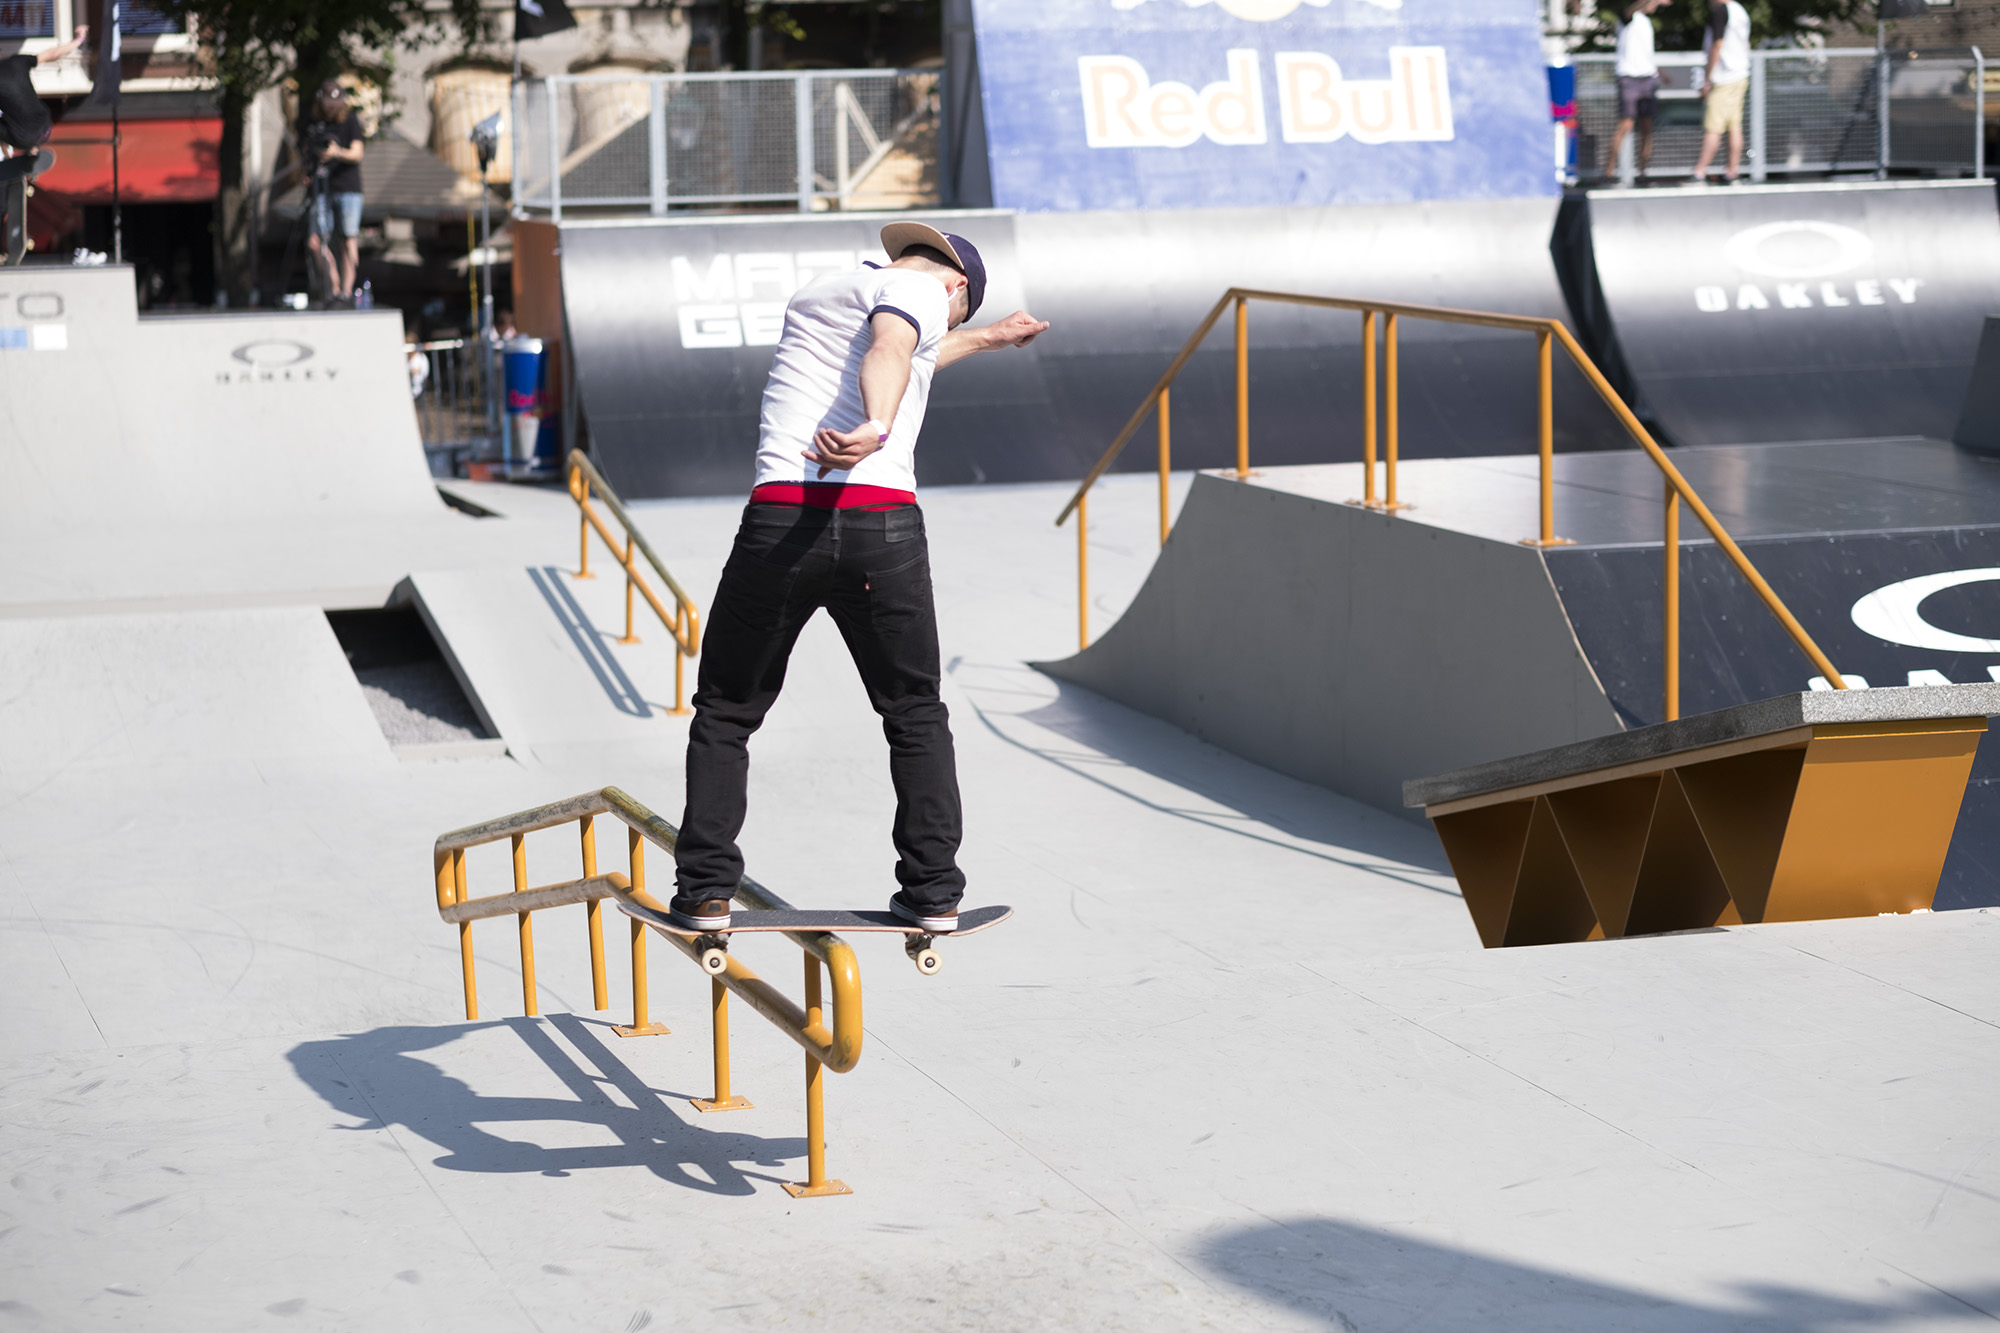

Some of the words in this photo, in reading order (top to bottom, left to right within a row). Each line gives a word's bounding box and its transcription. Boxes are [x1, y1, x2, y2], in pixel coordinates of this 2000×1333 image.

[1080, 48, 1266, 147] Red
[1276, 46, 1453, 143] Bull
[1694, 278, 1921, 312] OAKLEY
